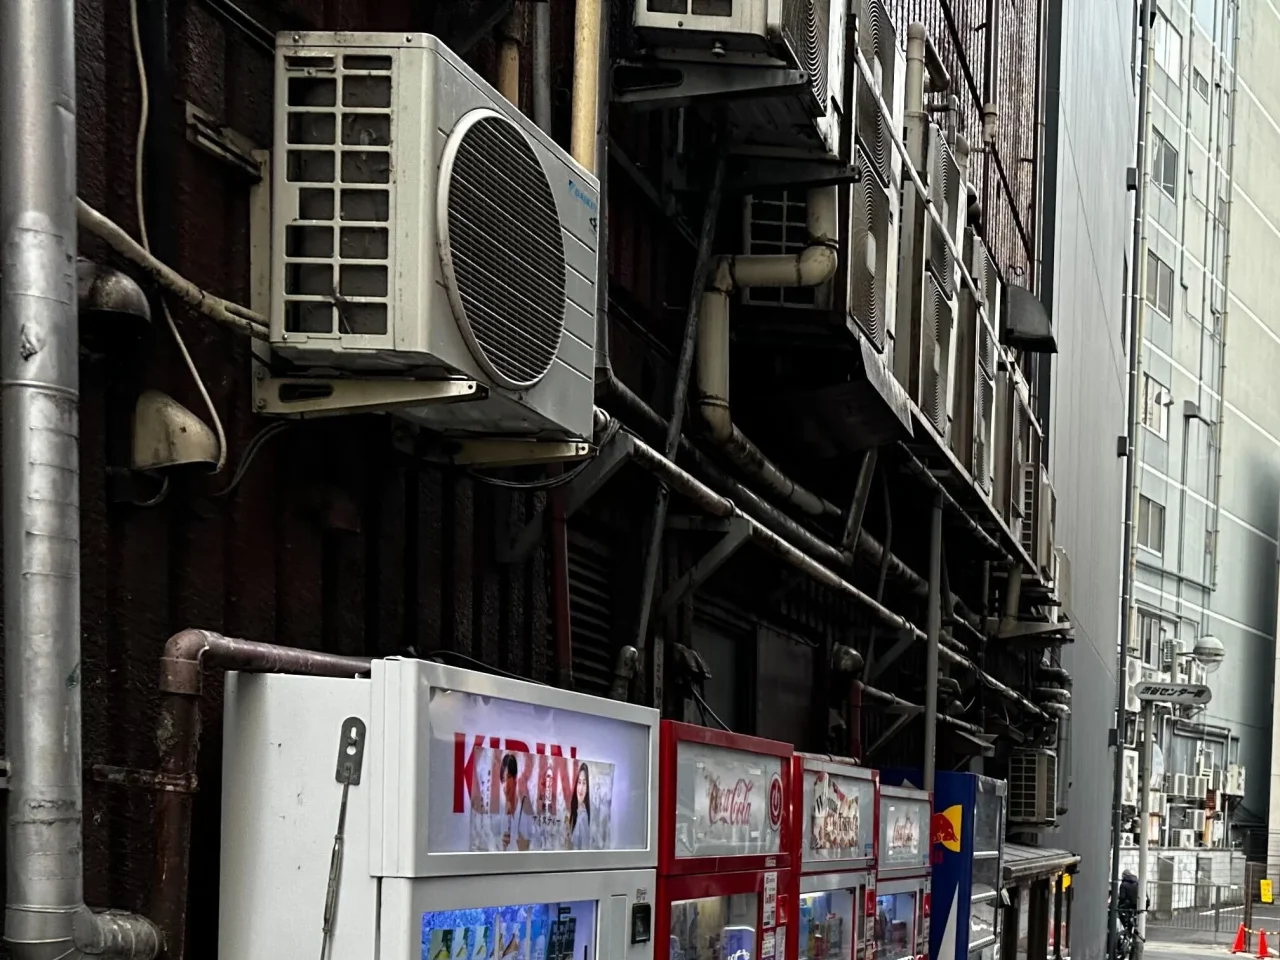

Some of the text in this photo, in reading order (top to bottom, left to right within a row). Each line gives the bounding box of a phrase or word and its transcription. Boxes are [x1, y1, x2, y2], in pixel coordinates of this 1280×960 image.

[1140, 685, 1207, 698] 渋谷センター街
[453, 732, 580, 815] KIRIN
